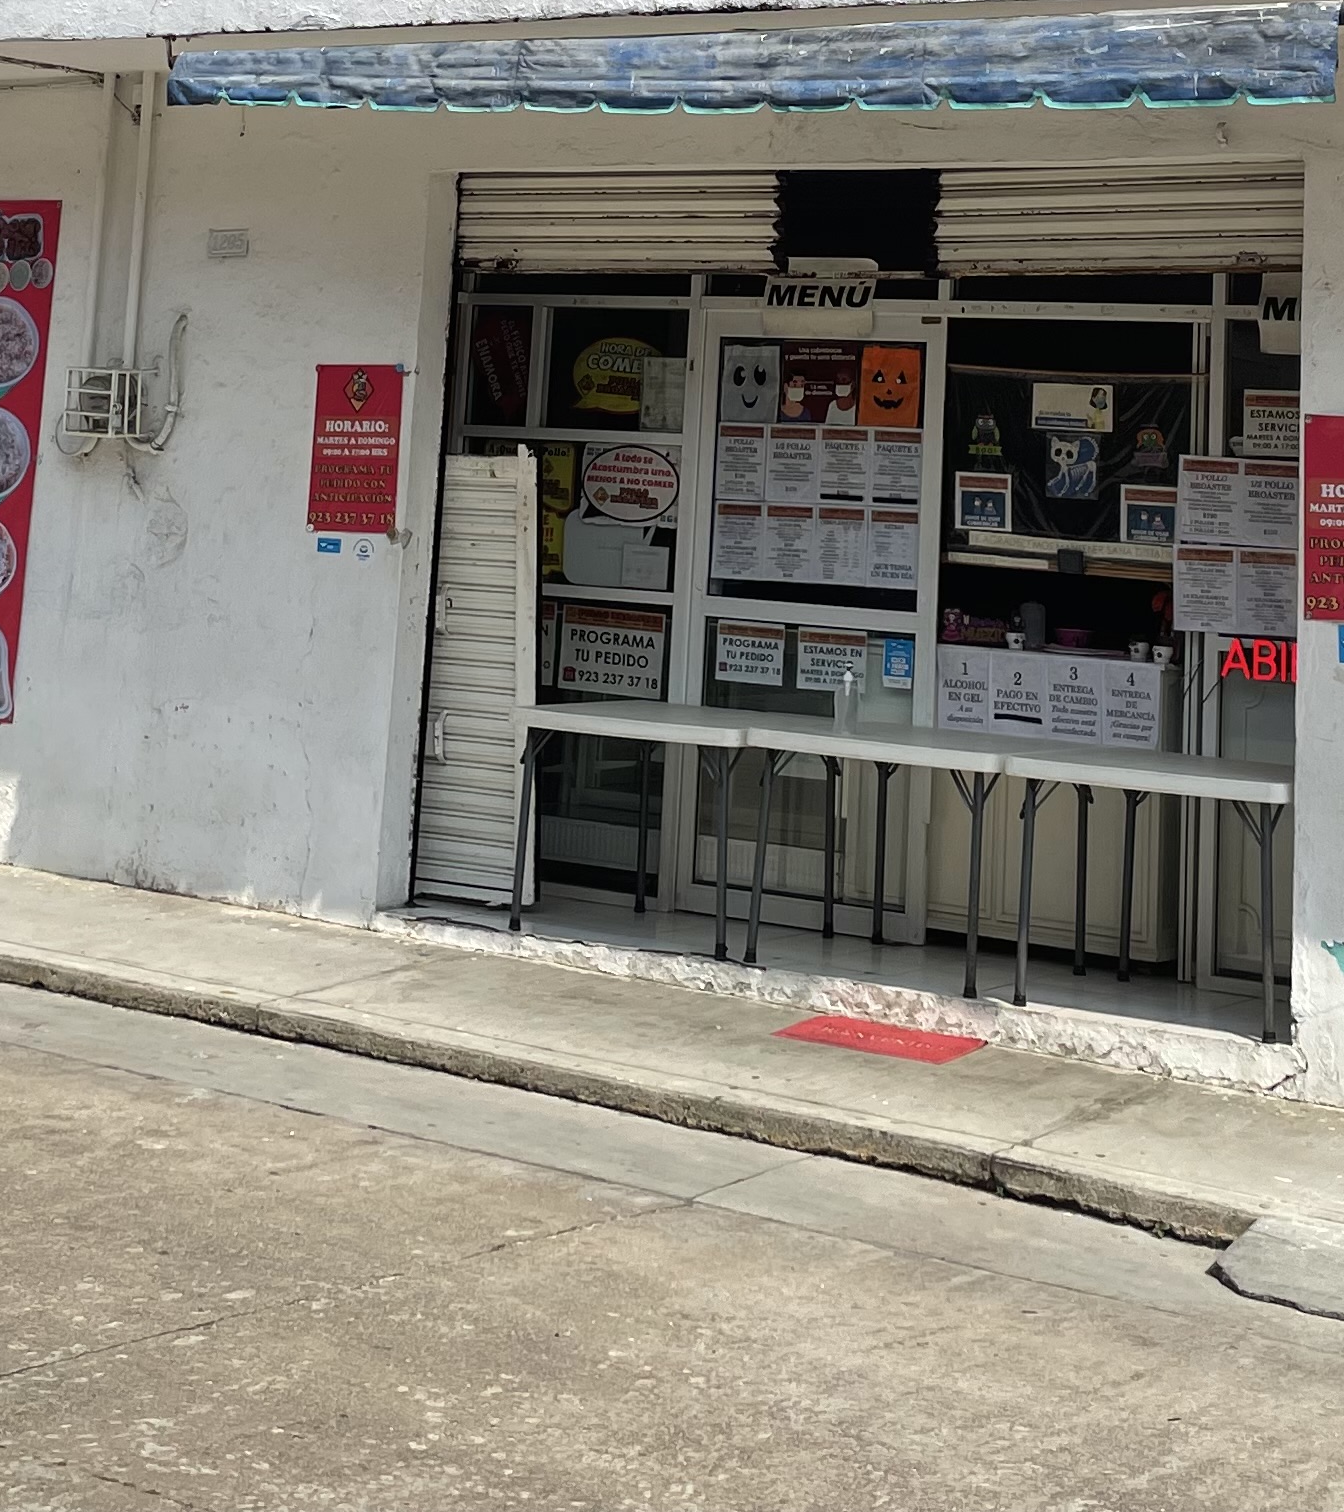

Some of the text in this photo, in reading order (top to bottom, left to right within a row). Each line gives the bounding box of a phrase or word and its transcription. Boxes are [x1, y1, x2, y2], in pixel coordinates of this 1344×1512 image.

[767, 280, 872, 308] MENÚ
[587, 356, 642, 374] COME
[1250, 410, 1300, 419] ESTAMOS
[326, 421, 389, 432] HORARIO:
[614, 453, 653, 464] A todo se
[591, 463, 649, 475] Acostumbra
[587, 475, 618, 484] MENOS
[642, 478, 674, 488] COMER
[309, 512, 394, 524] 923 237 37 18
[1305, 597, 1339, 611] 923
[570, 628, 656, 650] PROGRAMA
[722, 638, 780, 650] PROGRAMA
[726, 649, 774, 662] TU PEDIDO
[804, 646, 862, 657] ESTAMOS EN
[574, 648, 649, 669] TU PEDIDO
[759, 666, 770, 674] 37
[962, 662, 968, 675] 1
[1070, 666, 1078, 680] 3
[578, 670, 657, 690] 923 237 37 18
[943, 679, 988, 690] ALCOHOL
[1014, 672, 1022, 685] 2
[1127, 672, 1135, 686] 4
[997, 689, 1039, 700] PAGO EN
[1053, 684, 1095, 695] ENTREGA
[1112, 689, 1151, 700] ENTREGA
[948, 692, 983, 703] EN GEL
[1049, 693, 1098, 706] DE CAMBIO
[994, 701, 1041, 713] EFECTIVO
[1126, 700, 1138, 709] DE
[1106, 709, 1155, 721] MERCANCÍA
